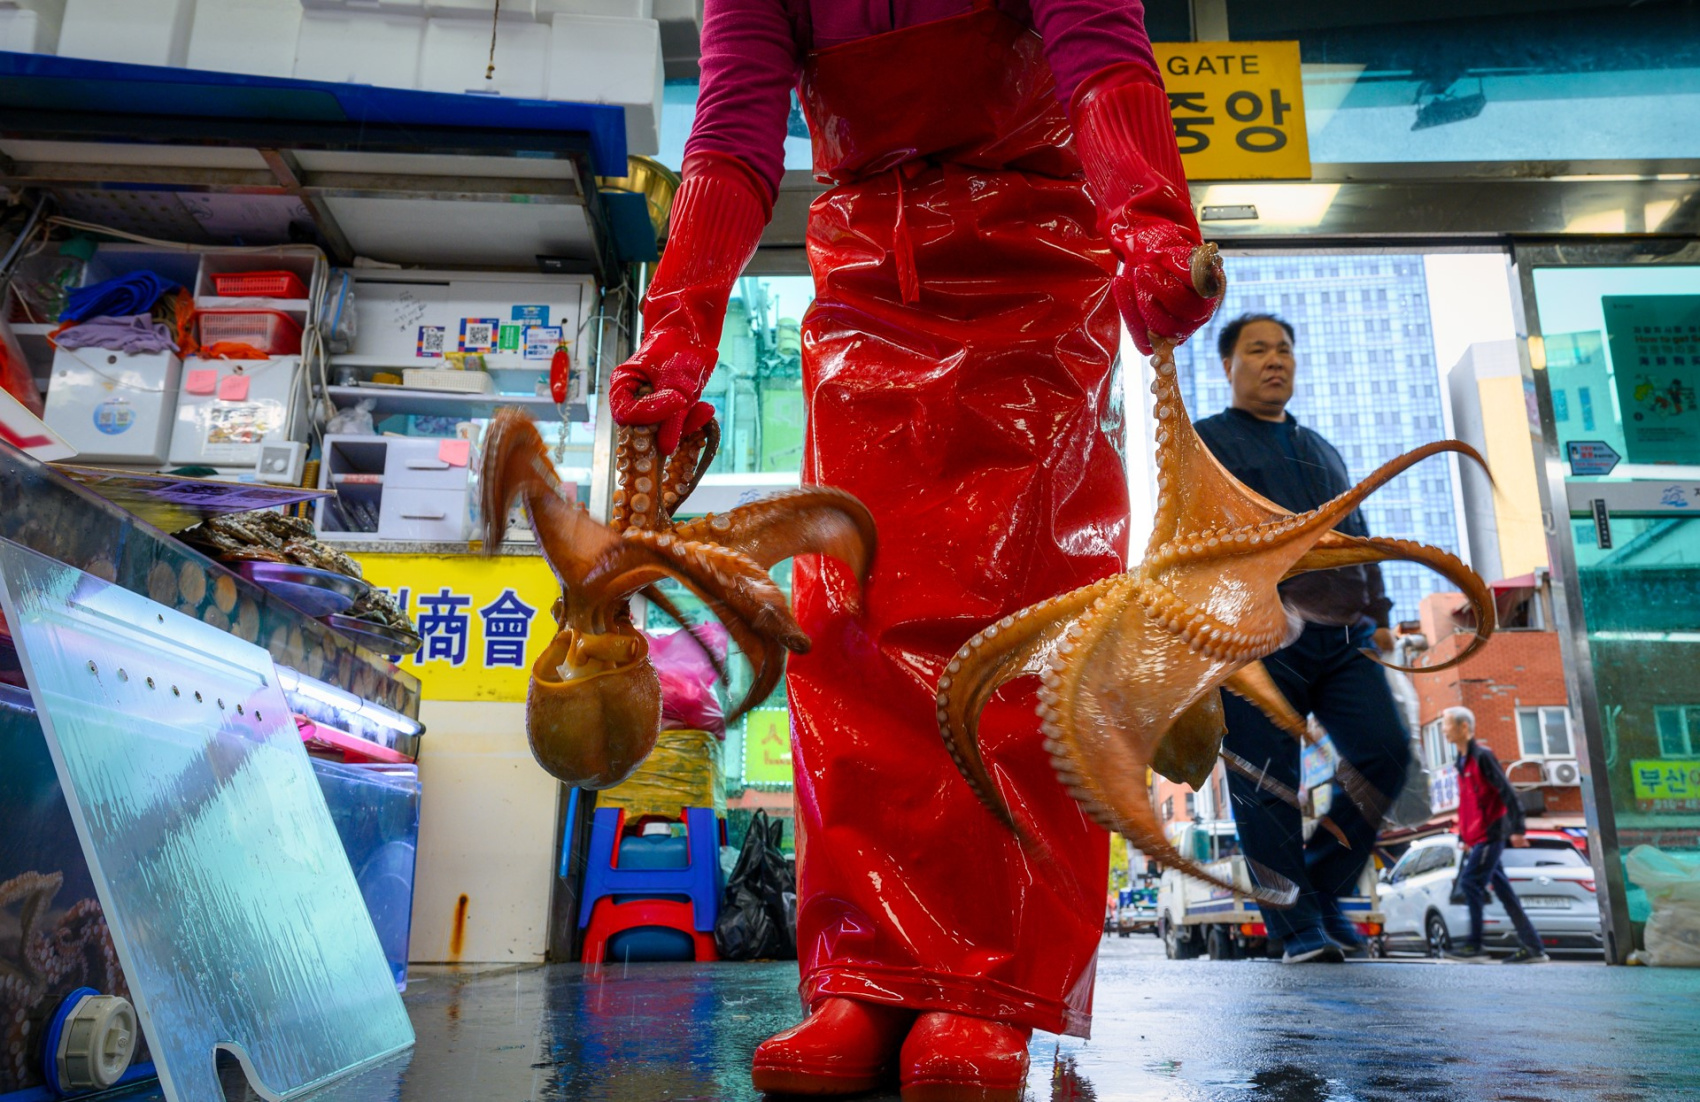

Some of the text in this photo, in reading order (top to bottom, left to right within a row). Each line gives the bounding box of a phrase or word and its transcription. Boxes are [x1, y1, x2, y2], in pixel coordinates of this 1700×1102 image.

[1166, 55, 1260, 76] GATE
[1166, 88, 1291, 155] 중앙
[1635, 335, 1658, 343] How
[1660, 335, 1671, 343] to
